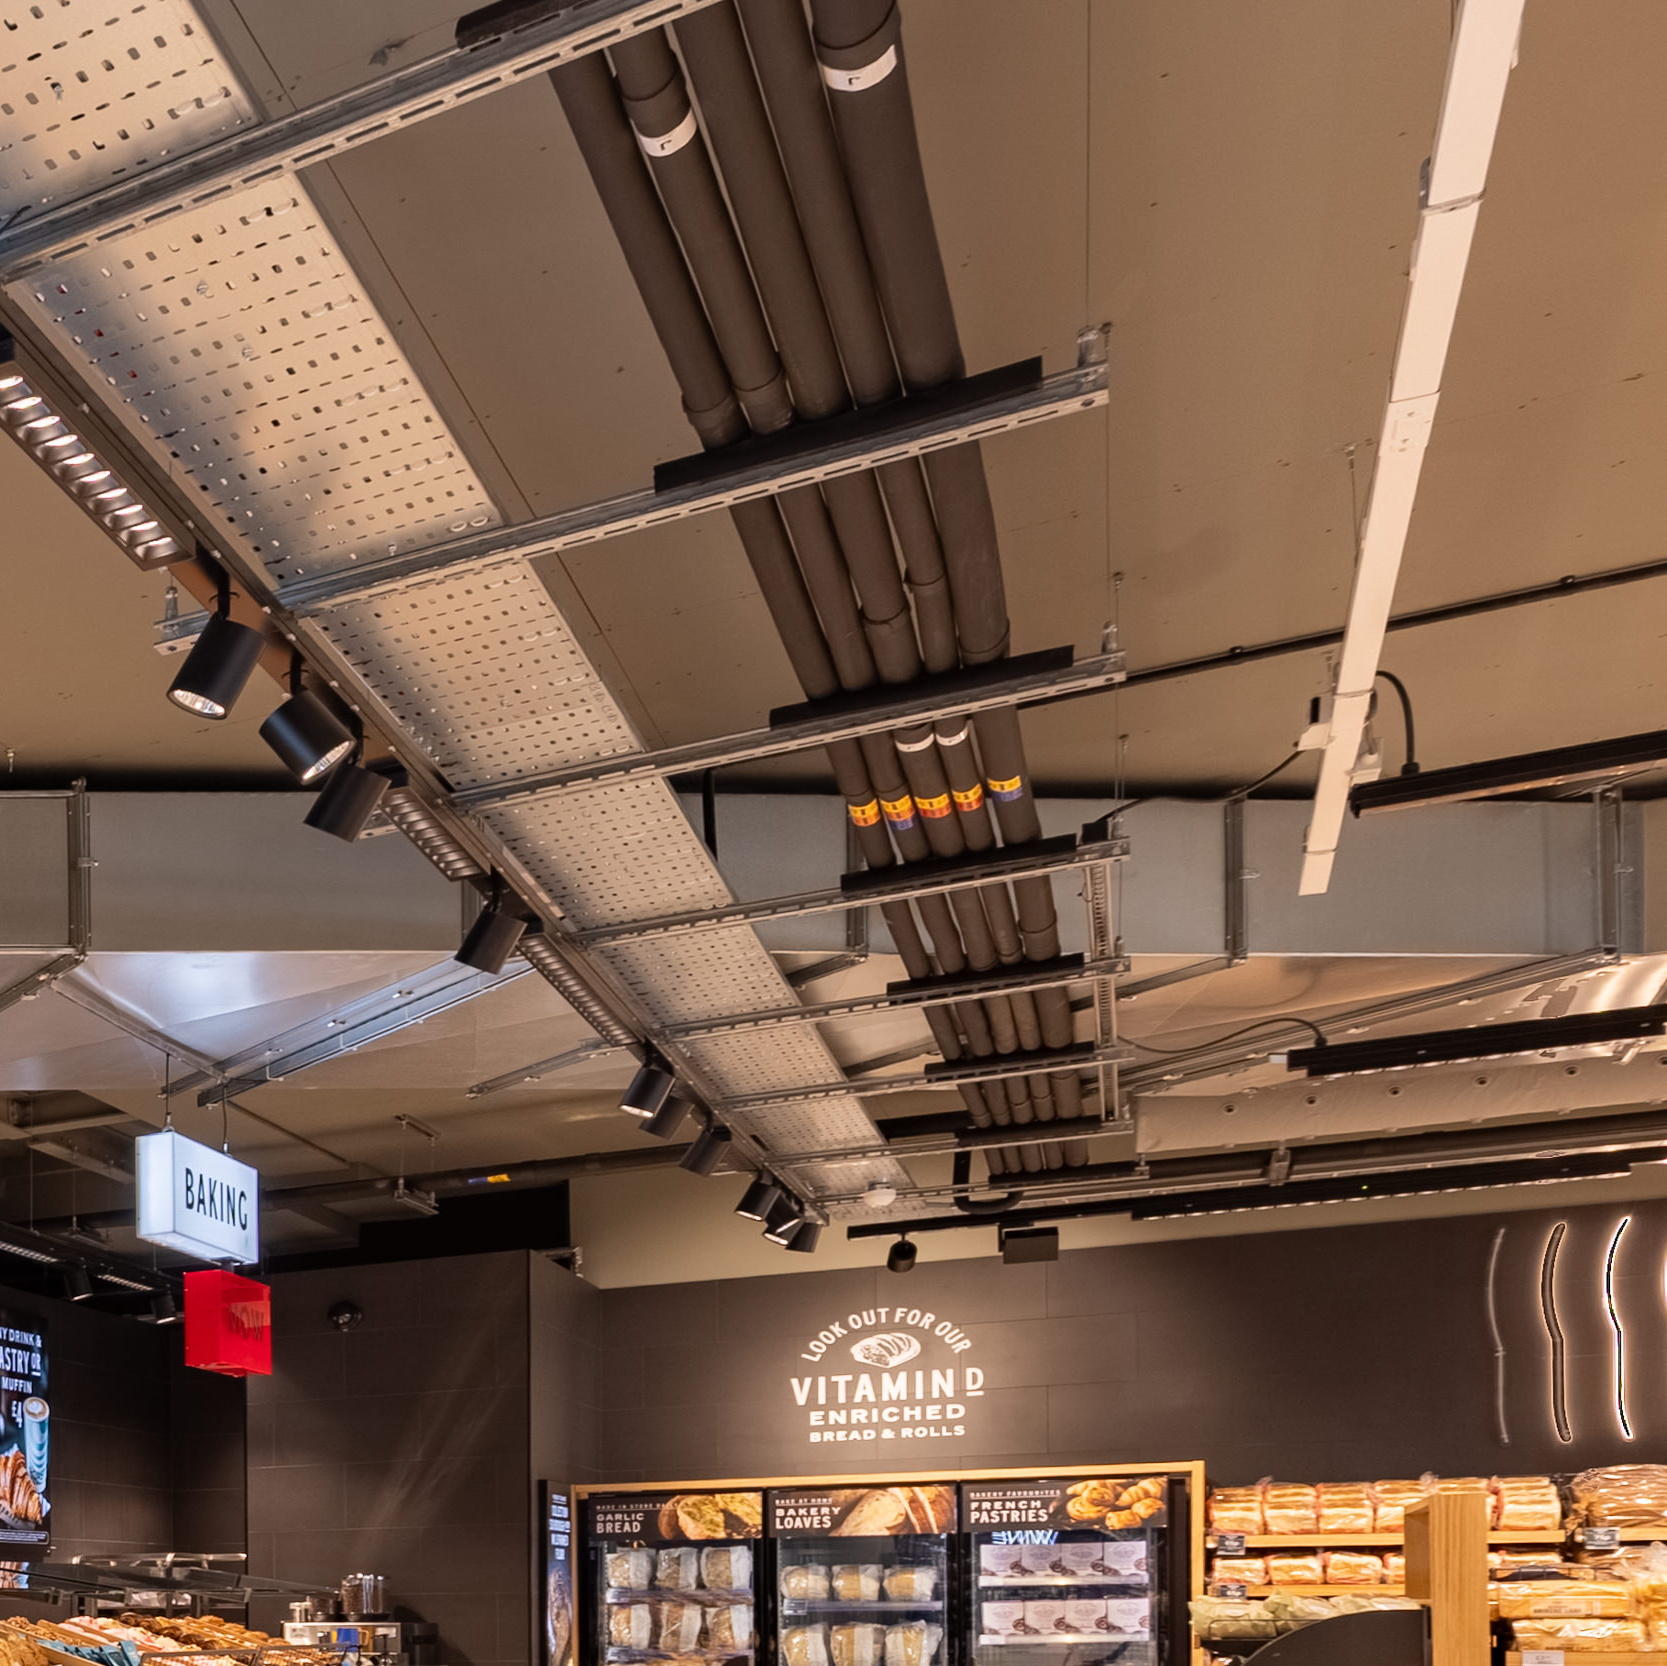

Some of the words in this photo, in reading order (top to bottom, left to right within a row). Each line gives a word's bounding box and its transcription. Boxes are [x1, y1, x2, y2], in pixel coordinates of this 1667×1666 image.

[185, 1168, 248, 1231] BAKING
[228, 1302, 264, 1342] NOW
[8, 1328, 35, 1347] DRINK
[35, 1333, 43, 1348] &
[801, 1321, 848, 1362] LOOK
[848, 1308, 890, 1330] OUT
[894, 1307, 936, 1329] FOR
[934, 1321, 972, 1354] OUR
[31, 1353, 42, 1372] OR
[1, 1376, 33, 1394] MUFFIN
[790, 1368, 955, 1406] VITAMIN
[965, 1367, 985, 1391] D
[809, 1403, 966, 1426] ENRICHED
[809, 1429, 876, 1443] BREAD
[881, 1428, 896, 1439] &
[901, 1425, 966, 1438] ROLLS
[775, 1506, 841, 1517] BAKERY
[970, 1499, 1042, 1511] FRENCH
[596, 1513, 645, 1521] GARLIC
[775, 1516, 832, 1529] LOAVES
[970, 1507, 1050, 1523] PASTRIES
[596, 1521, 642, 1534] BREAD
